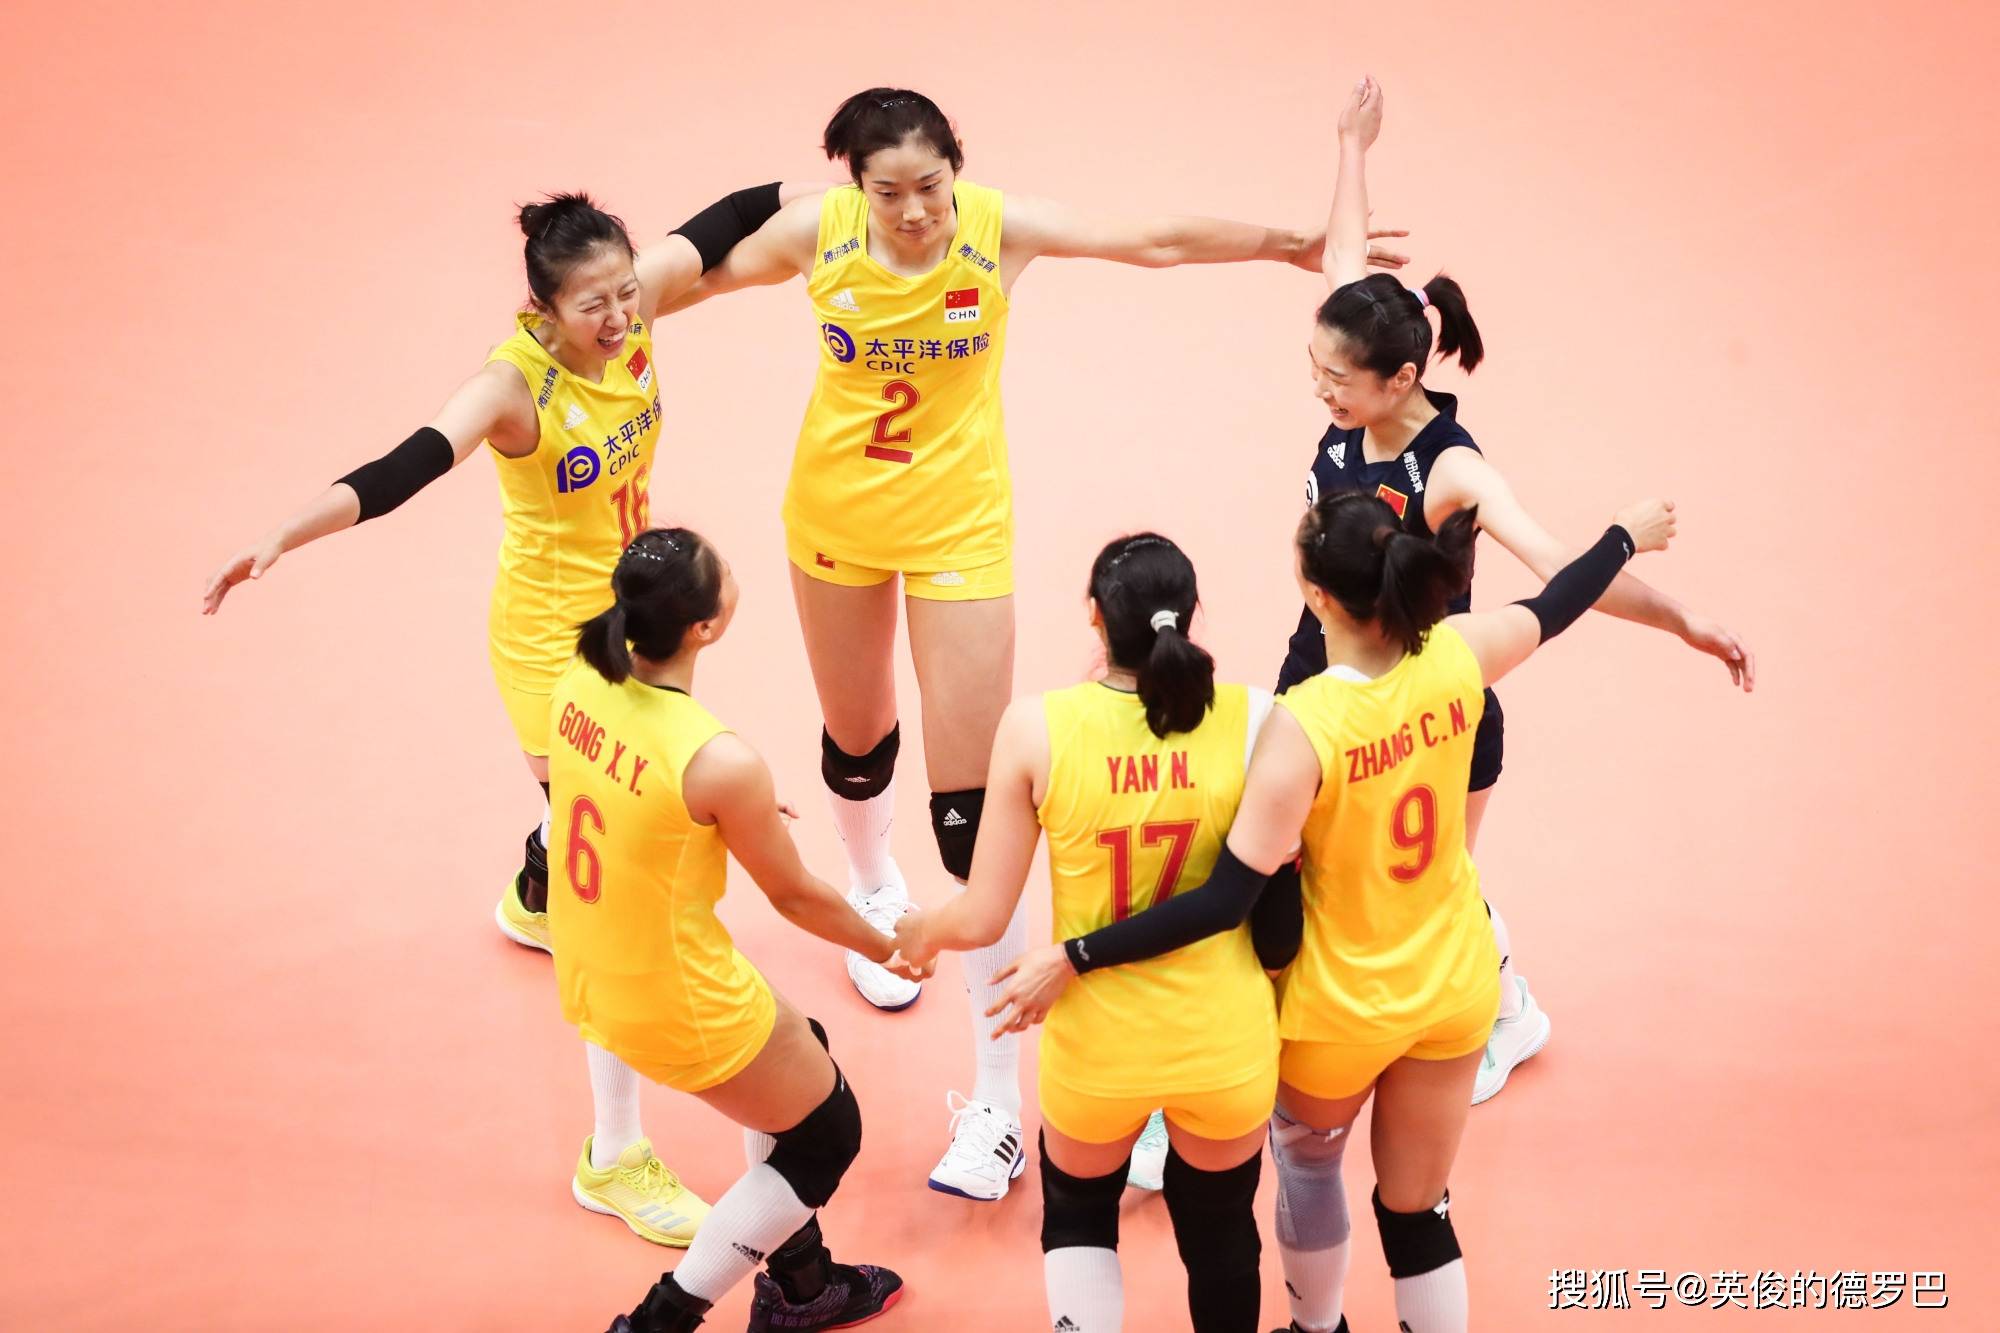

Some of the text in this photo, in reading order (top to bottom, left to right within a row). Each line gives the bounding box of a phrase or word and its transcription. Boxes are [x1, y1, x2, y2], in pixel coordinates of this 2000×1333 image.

[948, 310, 976, 320] CHN
[865, 333, 990, 360] 太平洋保险
[866, 360, 916, 374] CPIC
[871, 380, 920, 444] 2
[609, 444, 640, 475] CPIC
[559, 702, 605, 762] GONG
[1345, 723, 1413, 784] ZHANG
[1107, 751, 1196, 794] YAN N.
[943, 818, 967, 826] adidas
[1389, 784, 1438, 883] 9
[566, 795, 606, 904] 6
[1096, 819, 1199, 924] 17
